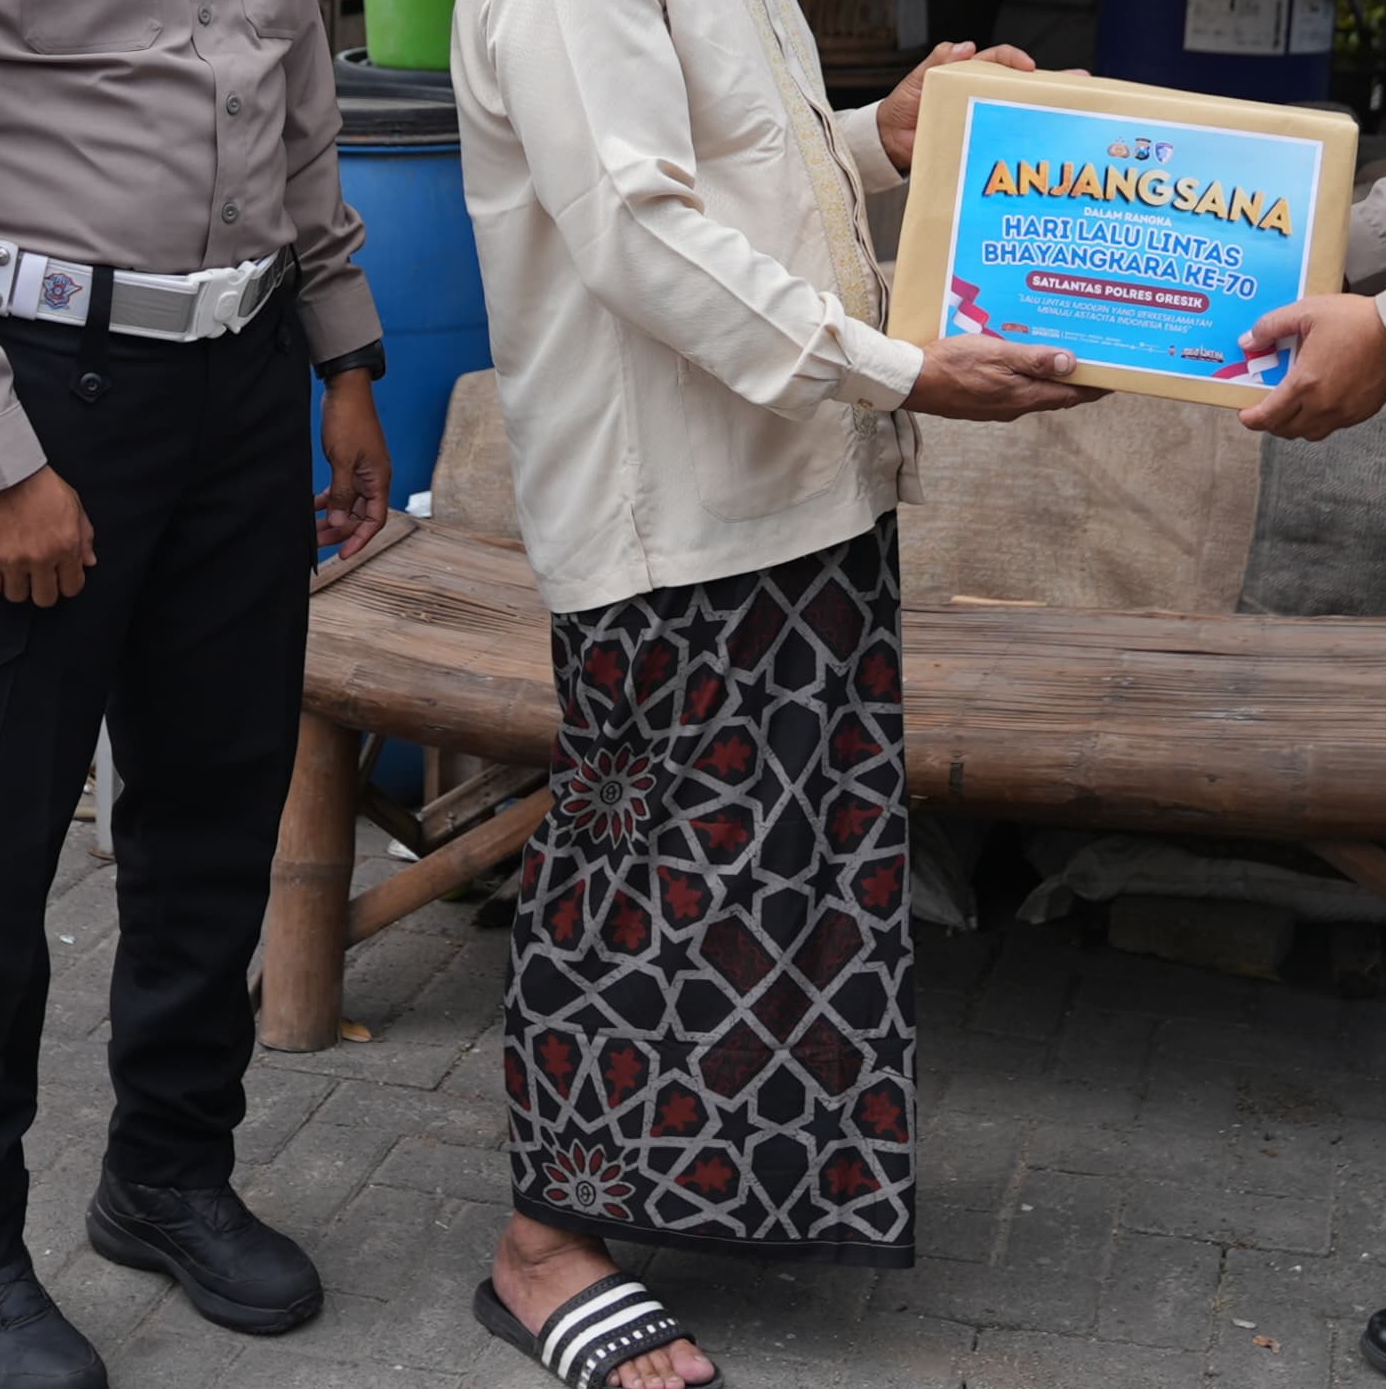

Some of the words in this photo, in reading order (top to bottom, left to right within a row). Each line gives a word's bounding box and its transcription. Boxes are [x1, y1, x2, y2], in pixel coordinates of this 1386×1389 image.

[984, 159, 1293, 237] ANJANGSANA
[1084, 207, 1123, 221] DALAM
[1124, 211, 1172, 227] RANGKA
[1003, 215, 1073, 241] HARI
[1077, 220, 1142, 249] LALU
[1147, 229, 1242, 268] LINTAS
[983, 240, 1180, 282] BHAYANGKARA
[1183, 262, 1258, 300] KE-70
[1031, 275, 1102, 296] SATLANTAS
[1105, 284, 1152, 302] POLRES
[1155, 291, 1203, 309] GRESIK
